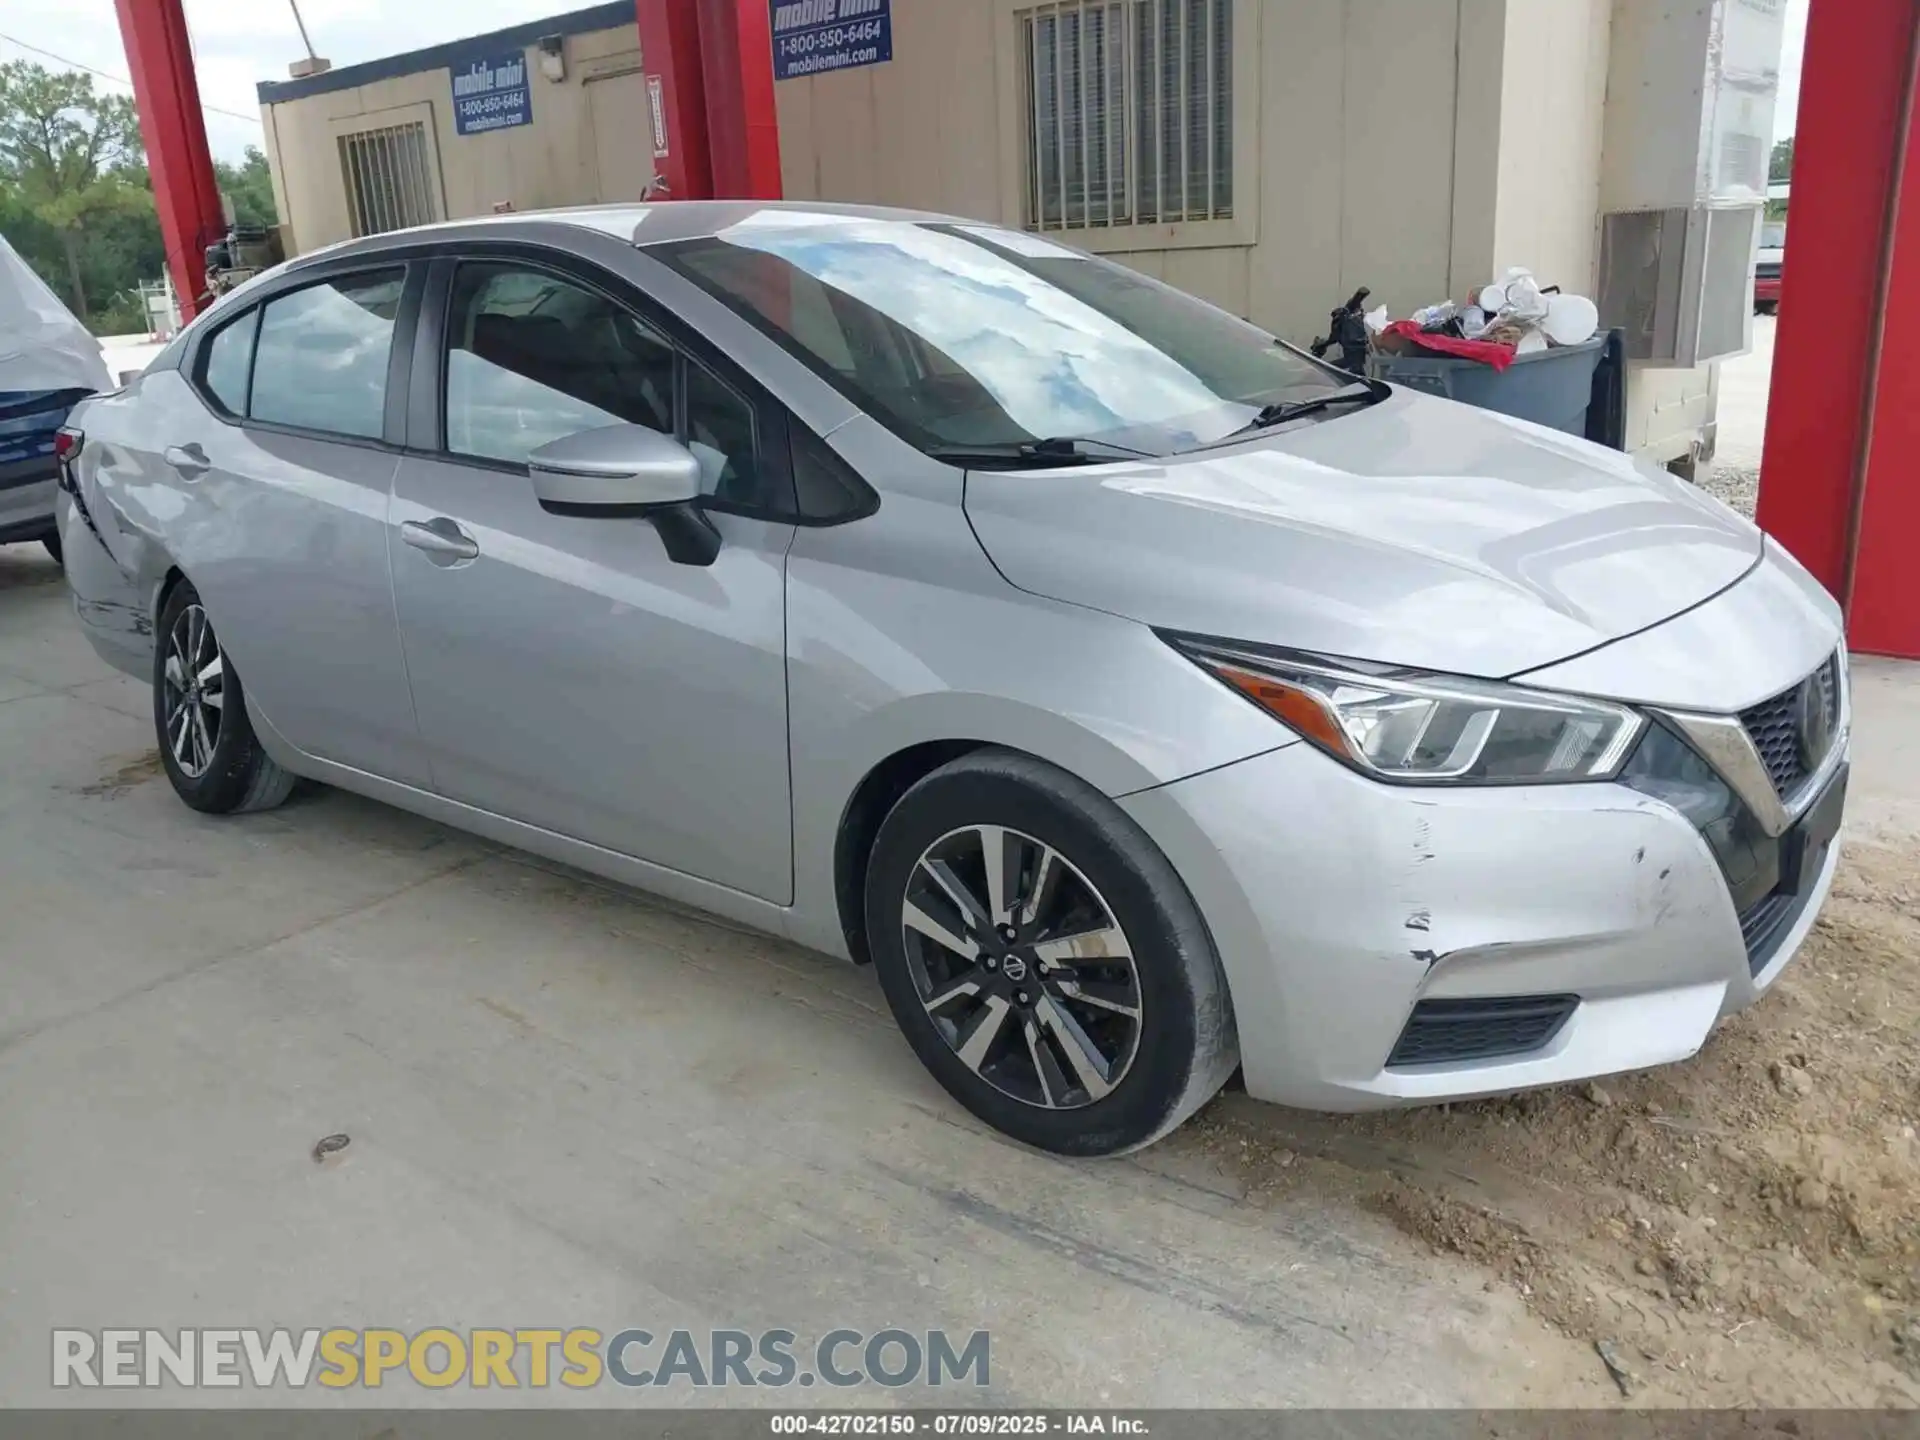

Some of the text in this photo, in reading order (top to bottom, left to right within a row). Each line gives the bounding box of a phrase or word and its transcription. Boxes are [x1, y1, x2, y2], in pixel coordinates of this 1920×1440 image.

[774, 0, 836, 31] mobile
[780, 19, 881, 56] 1-800-950-6464
[454, 57, 524, 97] mobile mini
[787, 46, 877, 75] mobilemini.com
